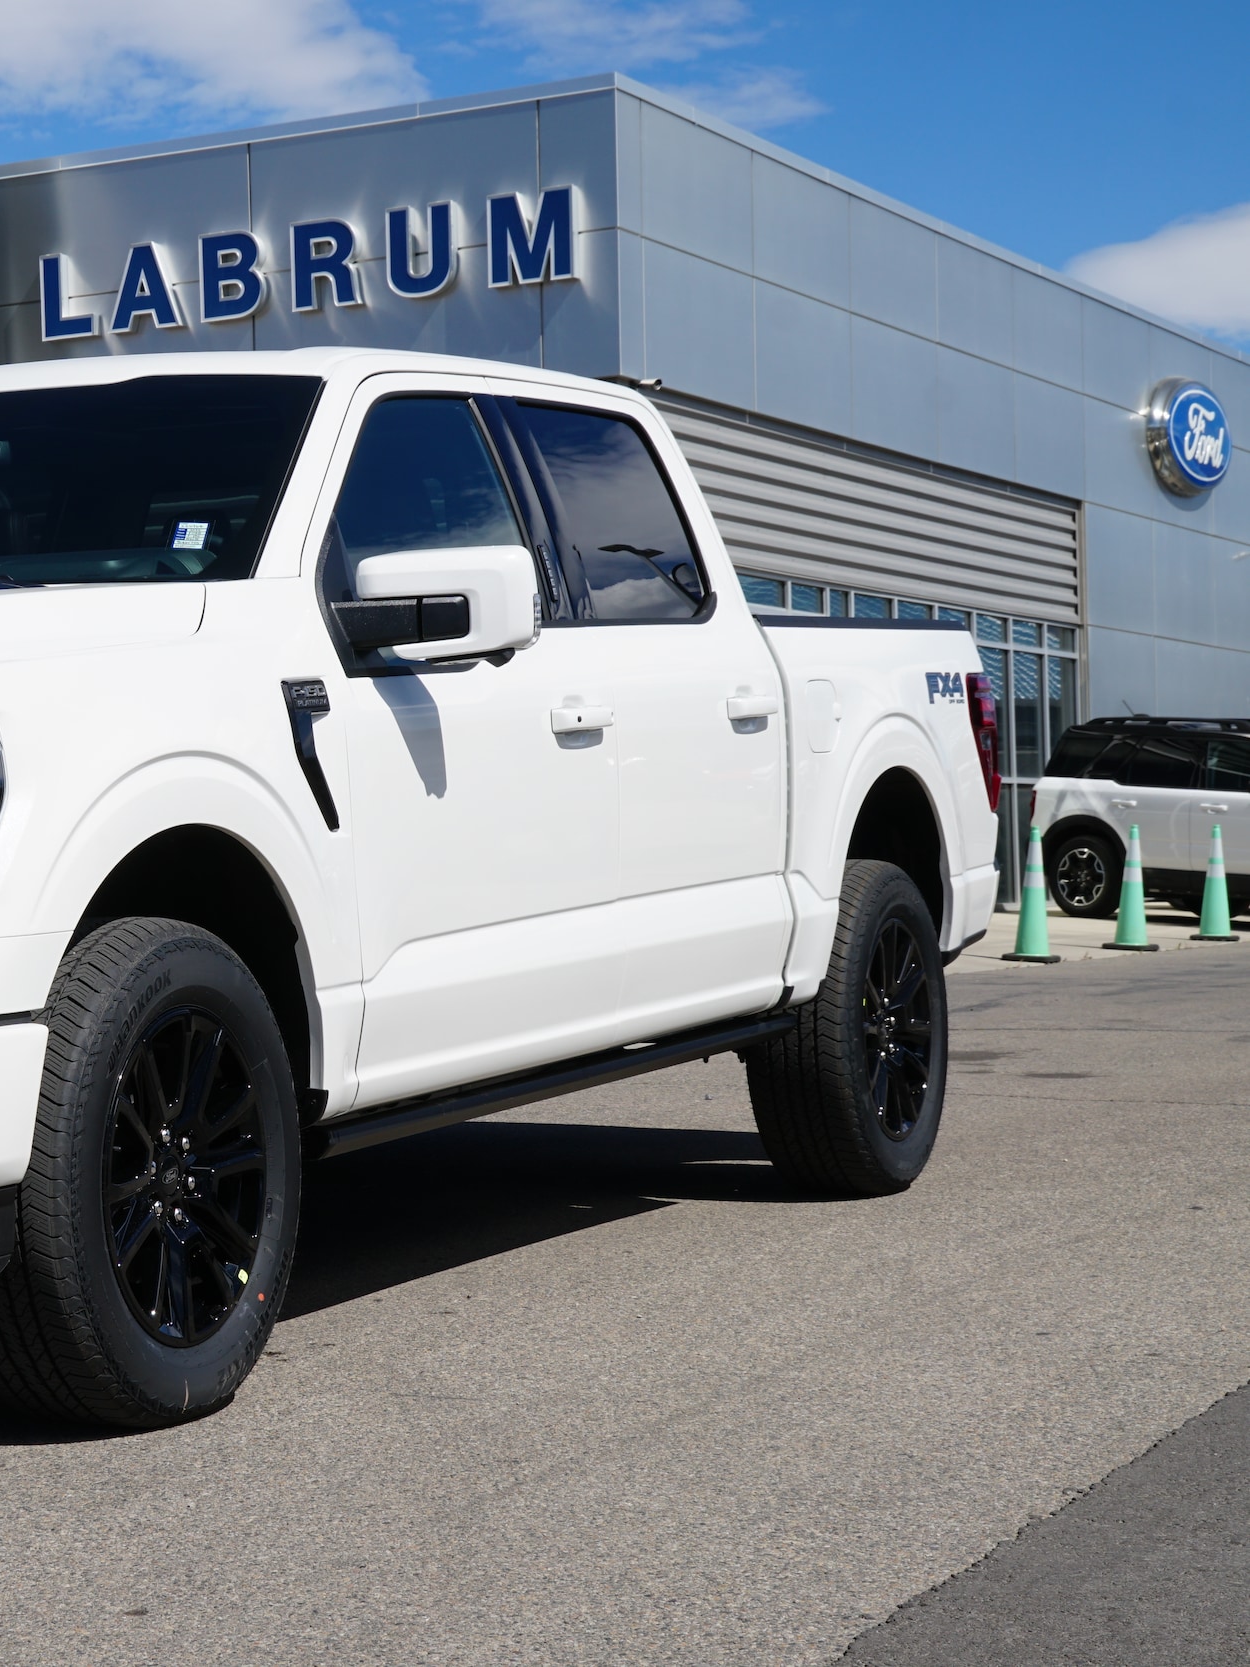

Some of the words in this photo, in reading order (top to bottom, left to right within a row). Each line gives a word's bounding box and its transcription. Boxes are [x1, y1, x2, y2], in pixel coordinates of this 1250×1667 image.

[39, 184, 581, 343] LABRUM
[1184, 402, 1225, 469] Ford
[291, 684, 327, 699] F-150
[925, 672, 964, 704] FX4
